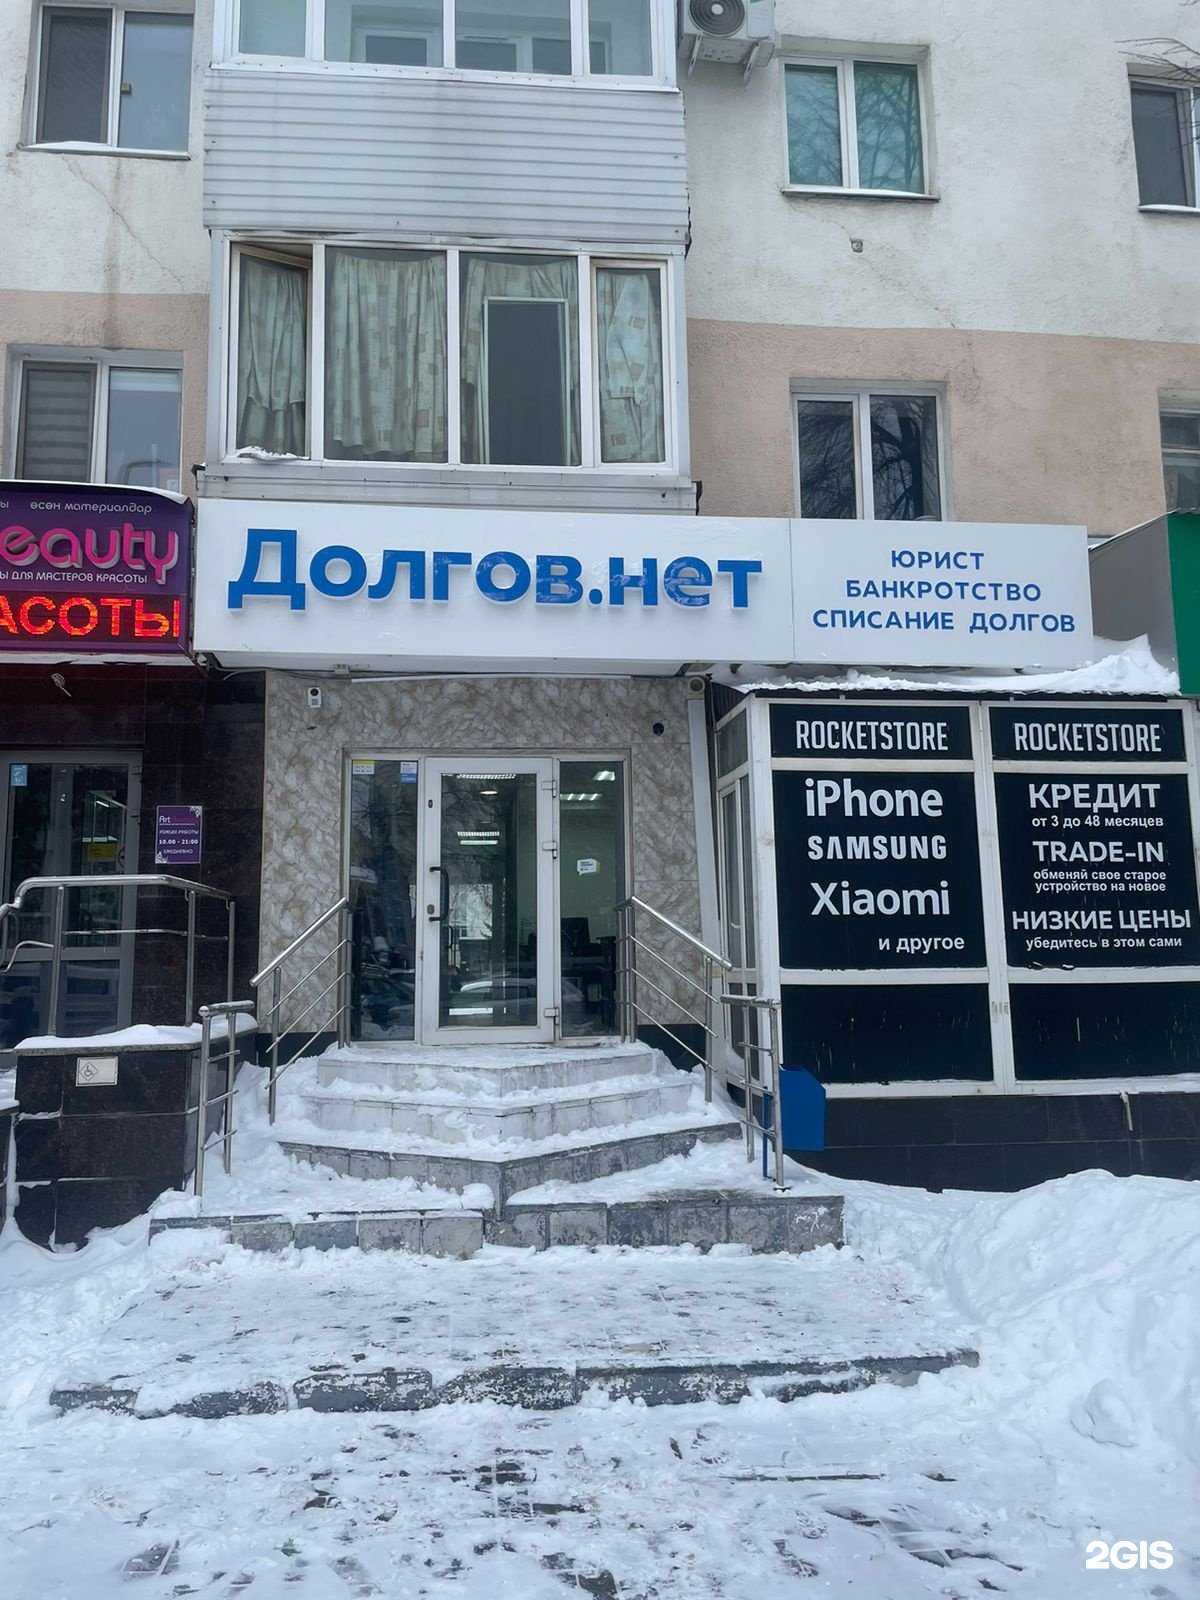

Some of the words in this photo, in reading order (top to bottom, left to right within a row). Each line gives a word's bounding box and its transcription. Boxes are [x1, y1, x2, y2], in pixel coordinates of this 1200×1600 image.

[64, 502, 153, 515] материалдар
[0, 522, 179, 585] eauty
[890, 550, 985, 570] ЮРИСТ
[11, 570, 34, 580] ДЛЯ
[36, 572, 94, 582] МАСТЕРОВ
[96, 573, 148, 584] КРАСОТЫ
[227, 527, 763, 611] Долгов.нет
[845, 579, 1042, 602] БАНКРОТСТВО
[812, 608, 955, 631] СПИСАНИЕ
[968, 613, 1076, 634] ДОЛГОВ
[795, 719, 949, 751] ROCKETSTORE
[1013, 722, 1162, 752] ROCKETSTORE
[804, 777, 944, 817] iPhone
[1028, 783, 1161, 813] КРЕДИТ
[1031, 817, 1048, 827] от
[1051, 815, 1059, 827] 3
[1063, 817, 1081, 829] до
[1084, 815, 1100, 827] 48
[1104, 816, 1164, 829] месяцев
[807, 835, 947, 860] SAMSUNG
[1032, 841, 1165, 862] TRADE-IN
[1033, 869, 1088, 880] обменяй
[1091, 872, 1121, 880] свое
[1124, 872, 1166, 882] старое
[1035, 880, 1108, 893] устройство
[1111, 883, 1125, 891] на
[1128, 883, 1166, 892] новое
[810, 880, 951, 916] Xiaomi
[1012, 910, 1113, 931] НИЗКИЕ
[1118, 909, 1192, 932] ЦЕНЫ
[878, 938, 890, 951] и
[896, 937, 965, 954] другое
[1026, 937, 1098, 951] убедитесь
[1101, 939, 1110, 948] в
[1113, 938, 1146, 948] этом
[1148, 937, 1182, 948] сами
